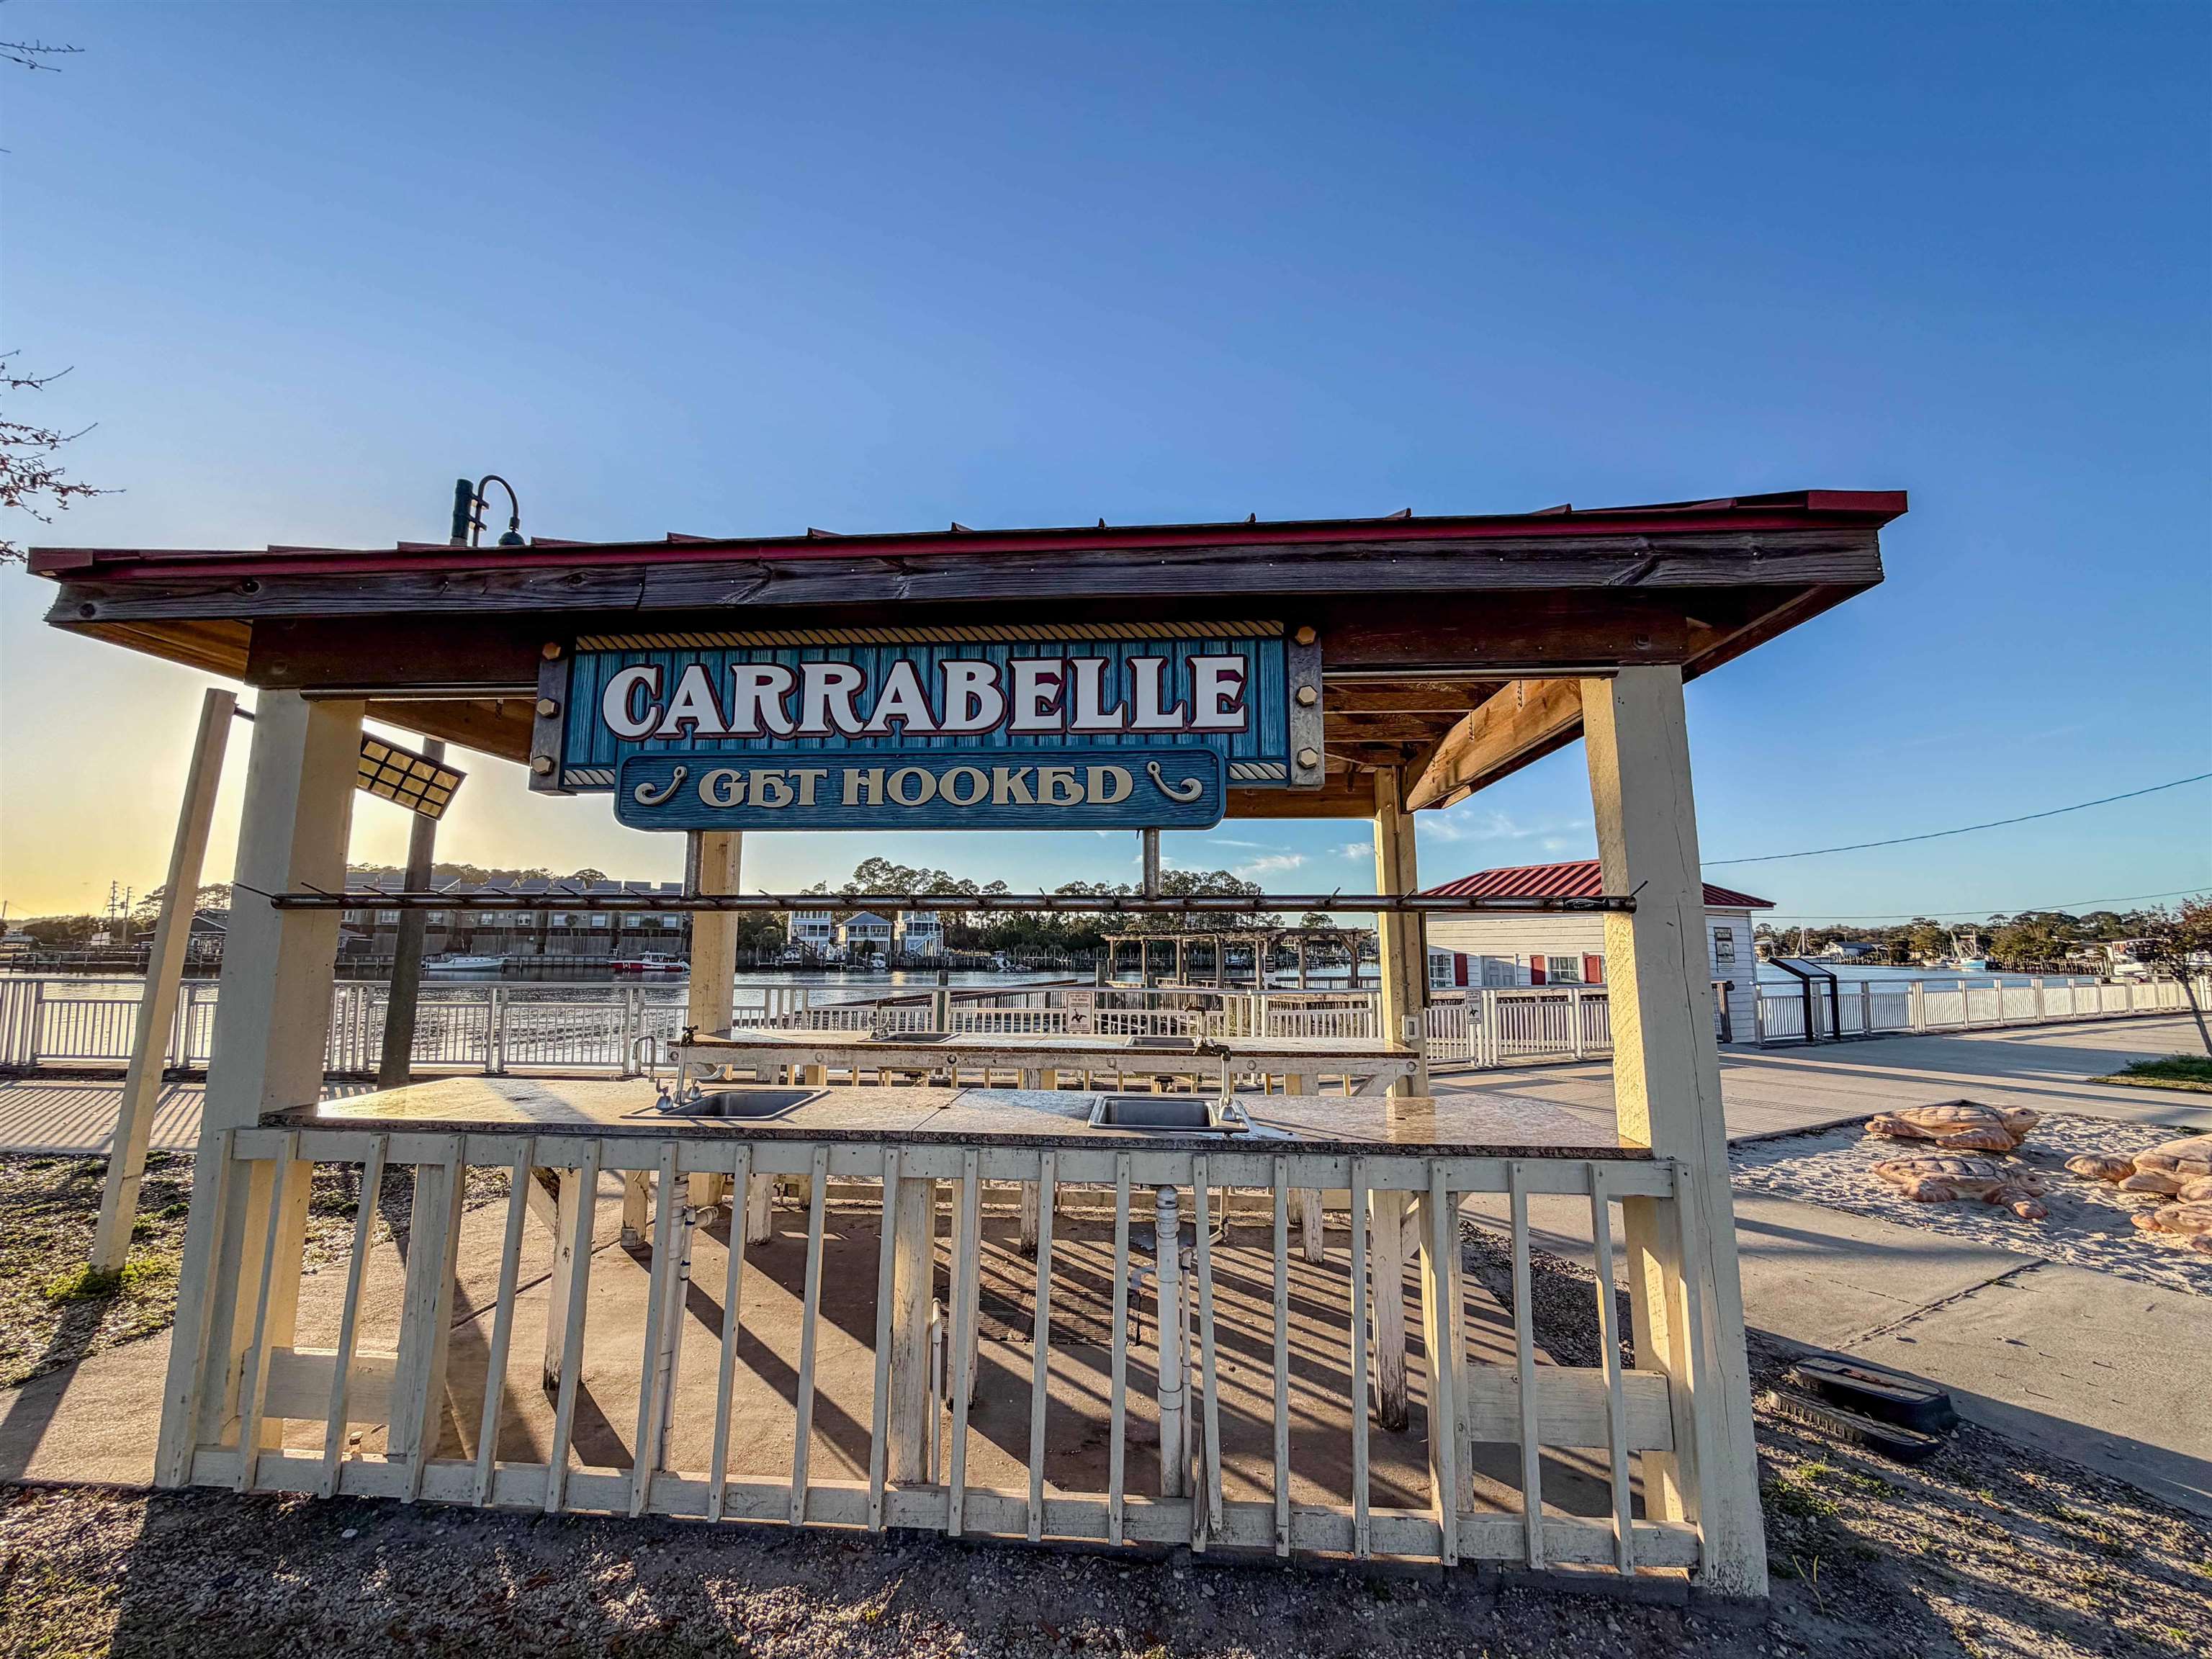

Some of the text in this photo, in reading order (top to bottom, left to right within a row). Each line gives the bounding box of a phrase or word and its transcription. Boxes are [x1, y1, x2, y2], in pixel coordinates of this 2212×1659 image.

[602, 655, 1247, 741] CARRABELLE
[698, 766, 1133, 807] GET HOOKED
